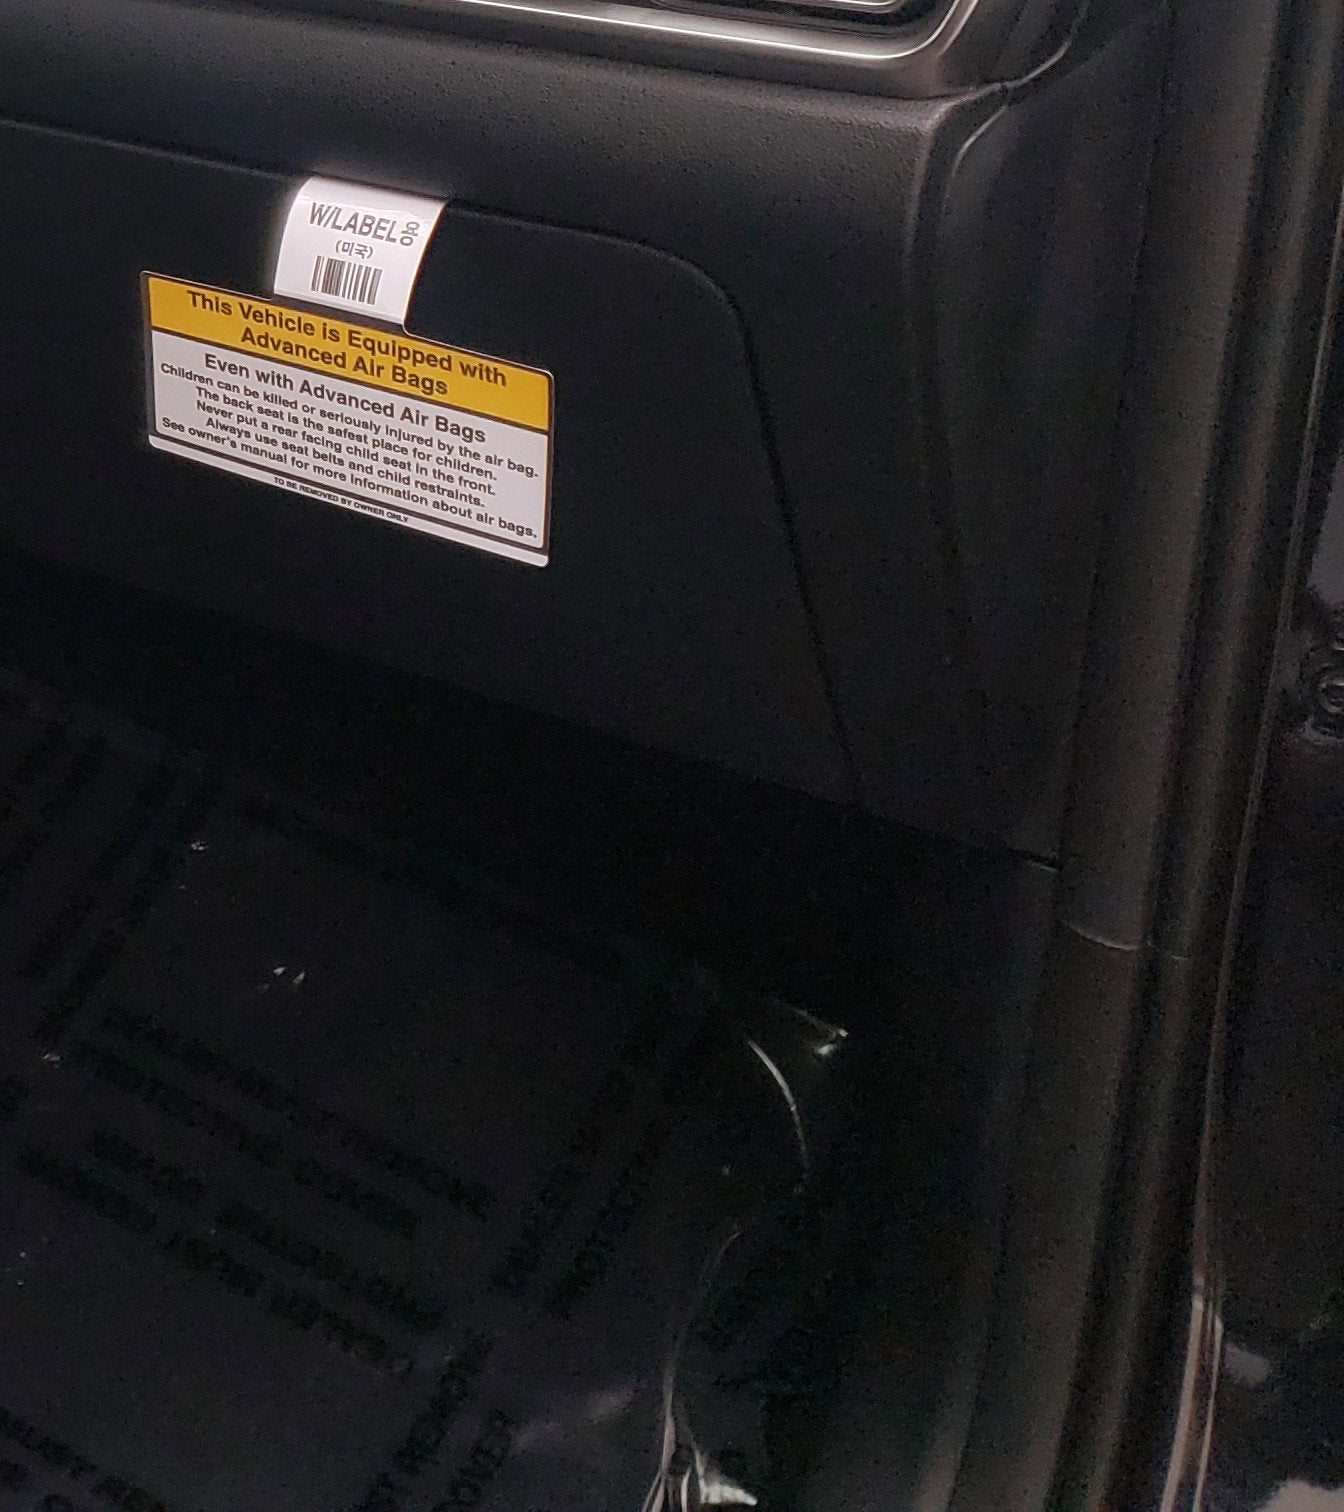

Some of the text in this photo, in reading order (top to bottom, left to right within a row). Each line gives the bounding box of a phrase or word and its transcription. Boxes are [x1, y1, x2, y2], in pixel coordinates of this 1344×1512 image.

[335, 239, 374, 260] (미국)
[186, 290, 507, 387] This Vehicle is Equipped with
[240, 327, 448, 396] Advanced Air Bags
[161, 362, 539, 478] Children can be killed or seriously injured by the air bag.
[196, 385, 498, 481] The back seat is the safest place for children.
[205, 353, 487, 444] Even with Advanced Air Bags
[162, 416, 538, 539] See owner's manual for more information about air bags.
[196, 399, 496, 496] Never put a rear facing child seat in the front.
[206, 417, 485, 508] Always use seat belts and child restraints.
[274, 476, 409, 523] TO BE REMOVED BY OWNER ONLY
